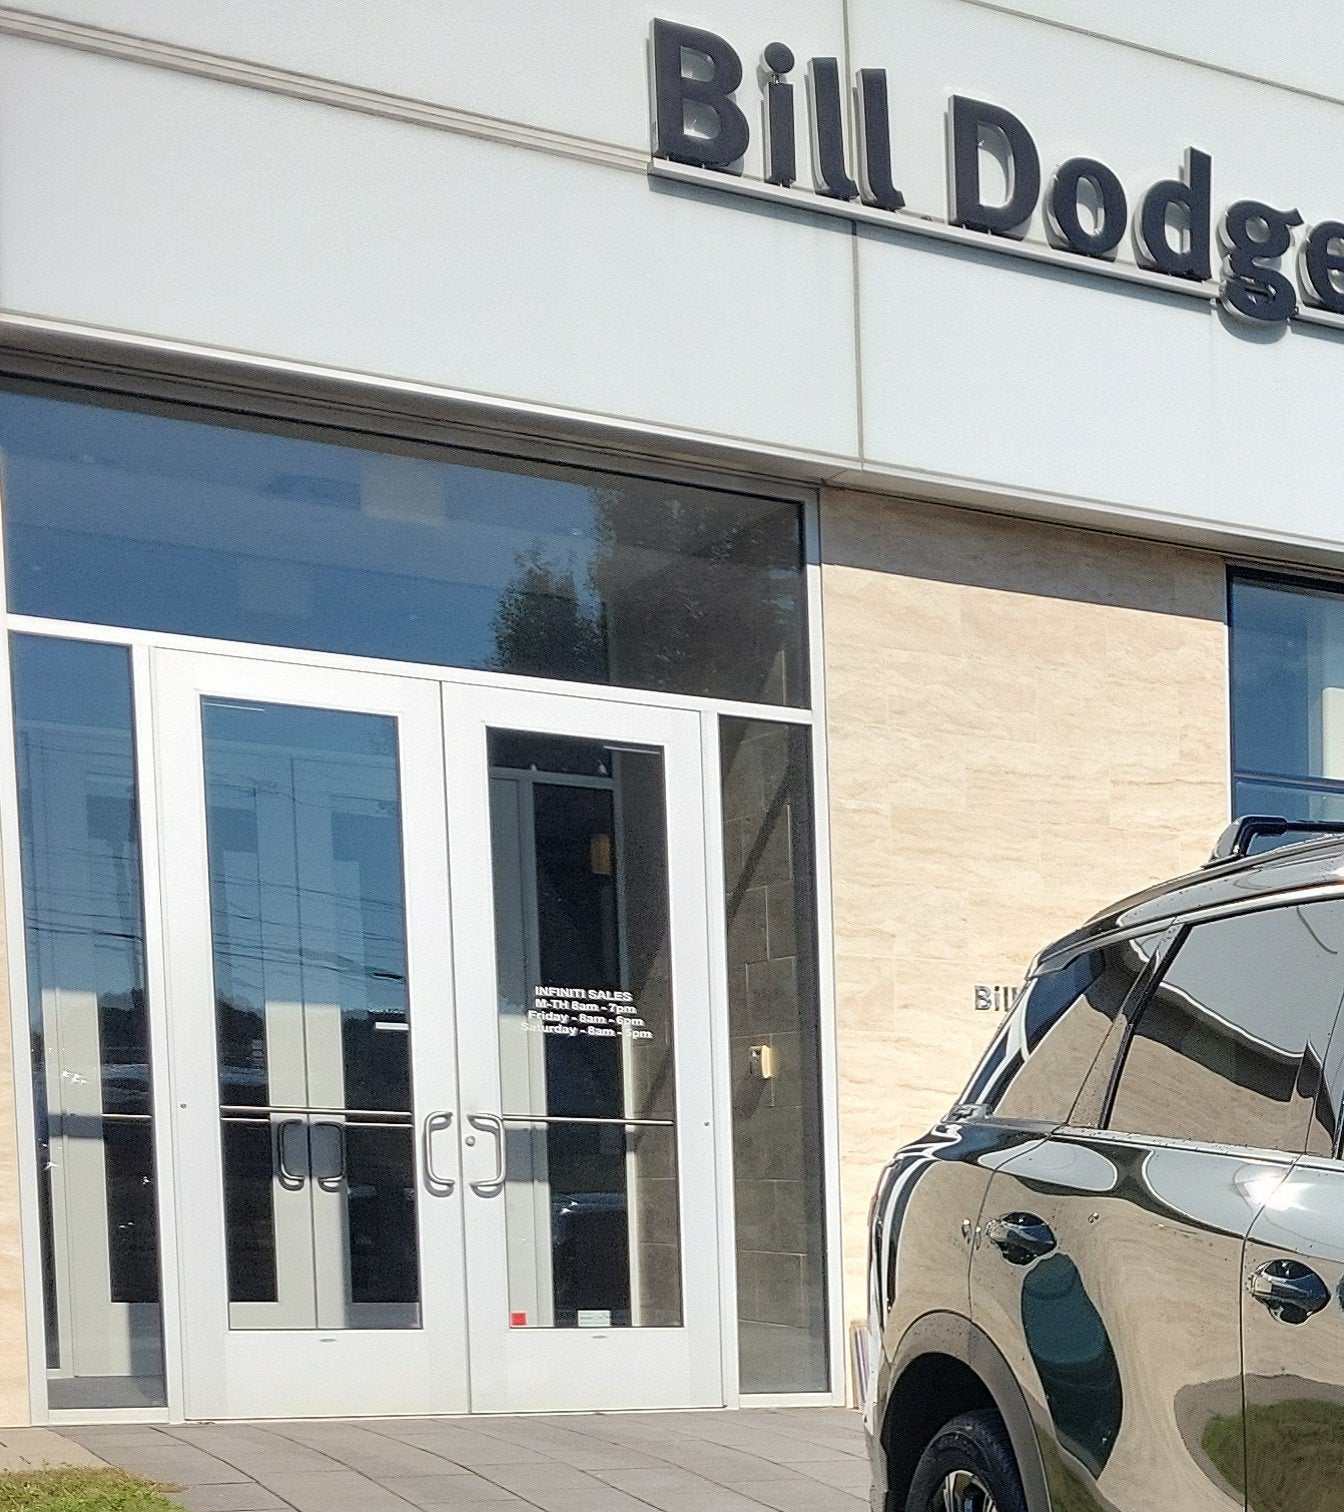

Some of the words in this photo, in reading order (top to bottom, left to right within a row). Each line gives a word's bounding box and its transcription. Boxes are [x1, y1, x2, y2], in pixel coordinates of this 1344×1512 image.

[649, 17, 905, 212] Bill
[535, 986, 586, 998] INFINITI
[588, 989, 634, 1002] SALES
[535, 998, 569, 1010] M-TH
[608, 1002, 638, 1015] 7pm
[528, 1010, 570, 1024] Friday
[520, 1021, 579, 1037] Saturday
[587, 1025, 616, 1037] 8am
